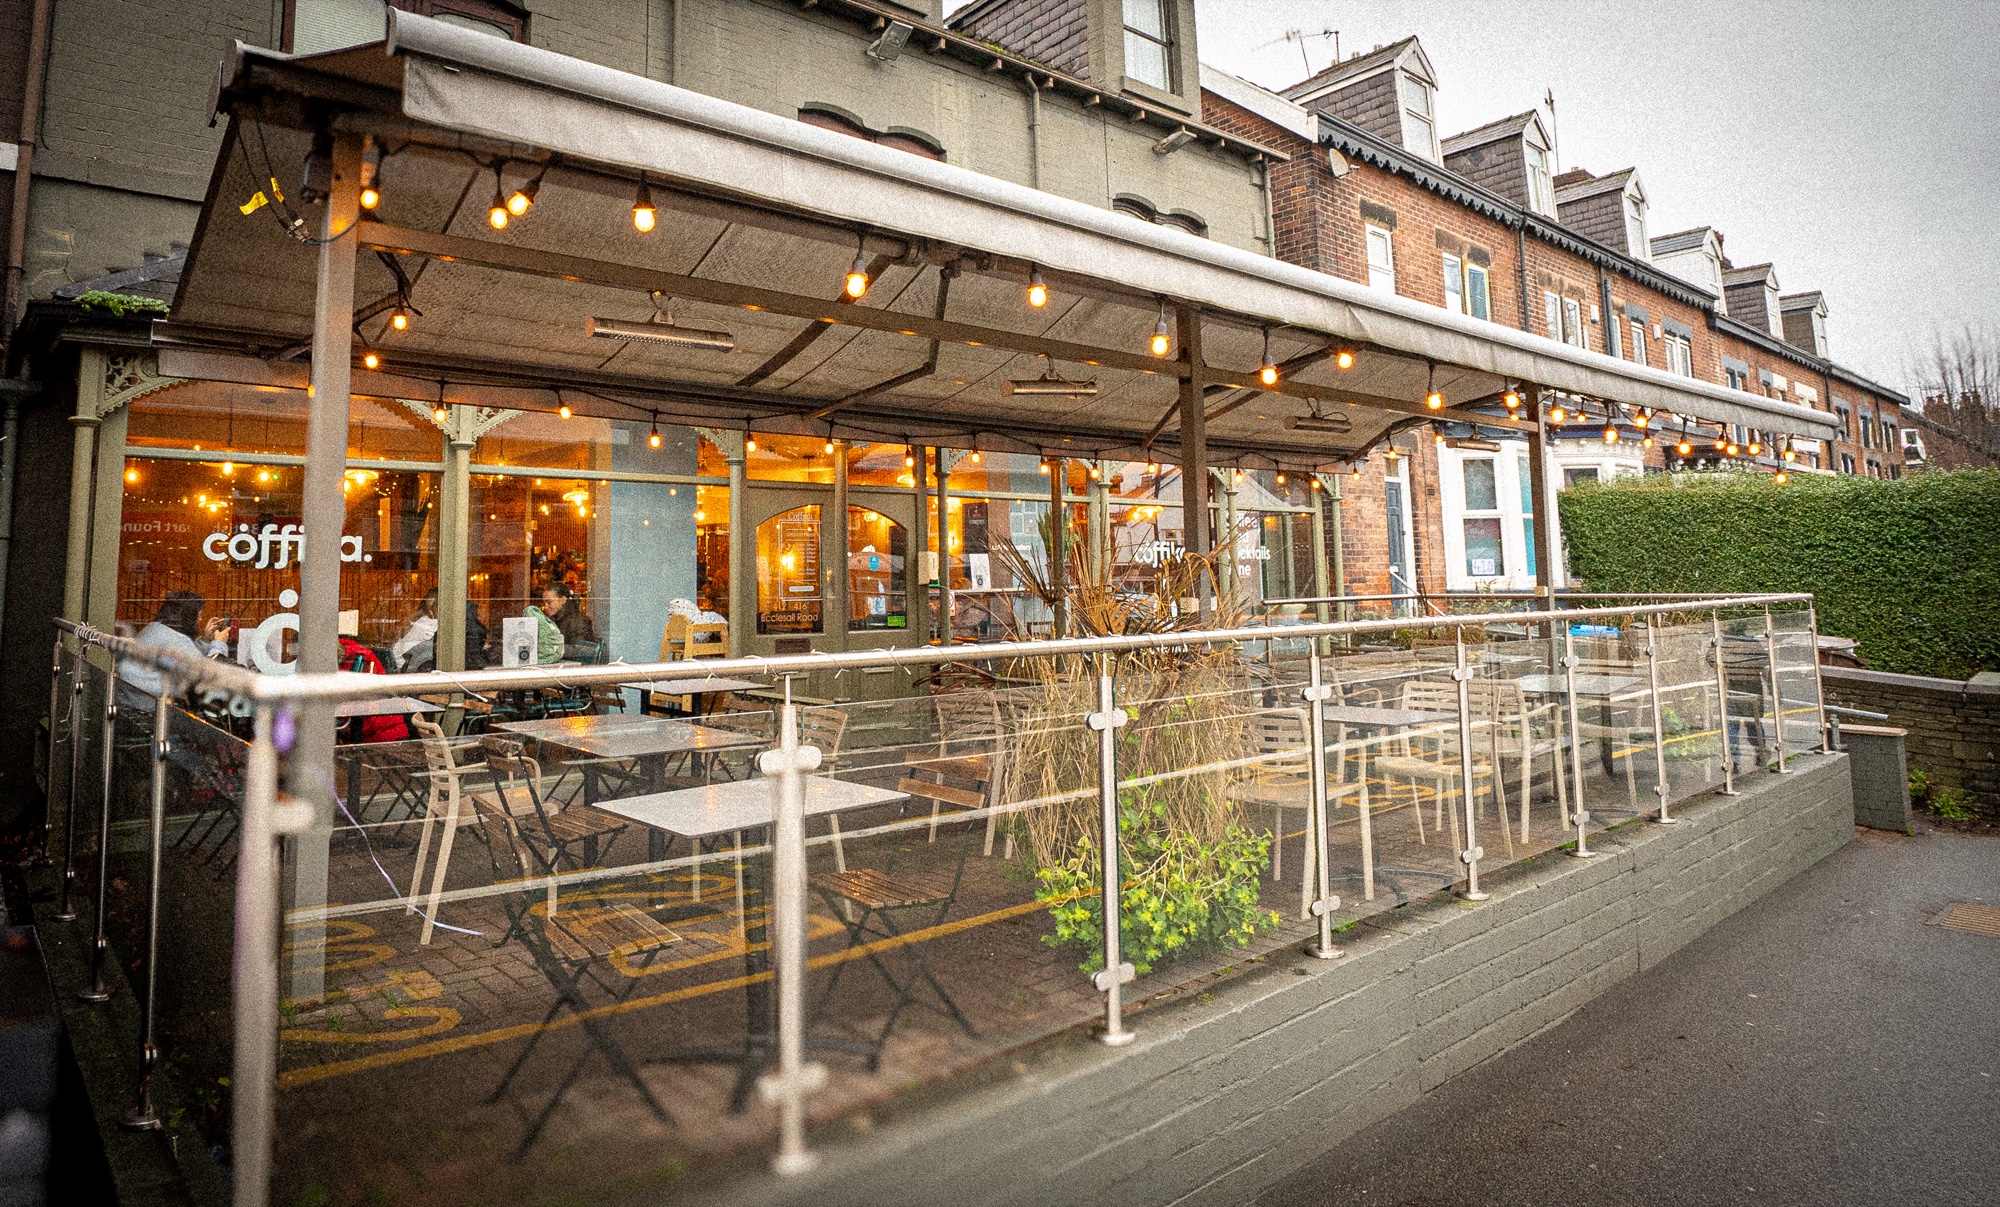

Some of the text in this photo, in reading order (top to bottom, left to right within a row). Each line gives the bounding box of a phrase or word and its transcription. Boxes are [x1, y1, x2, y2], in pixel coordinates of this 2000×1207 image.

[1228, 546, 1271, 560] cktails
[760, 613, 819, 623] Ecclesall Road
